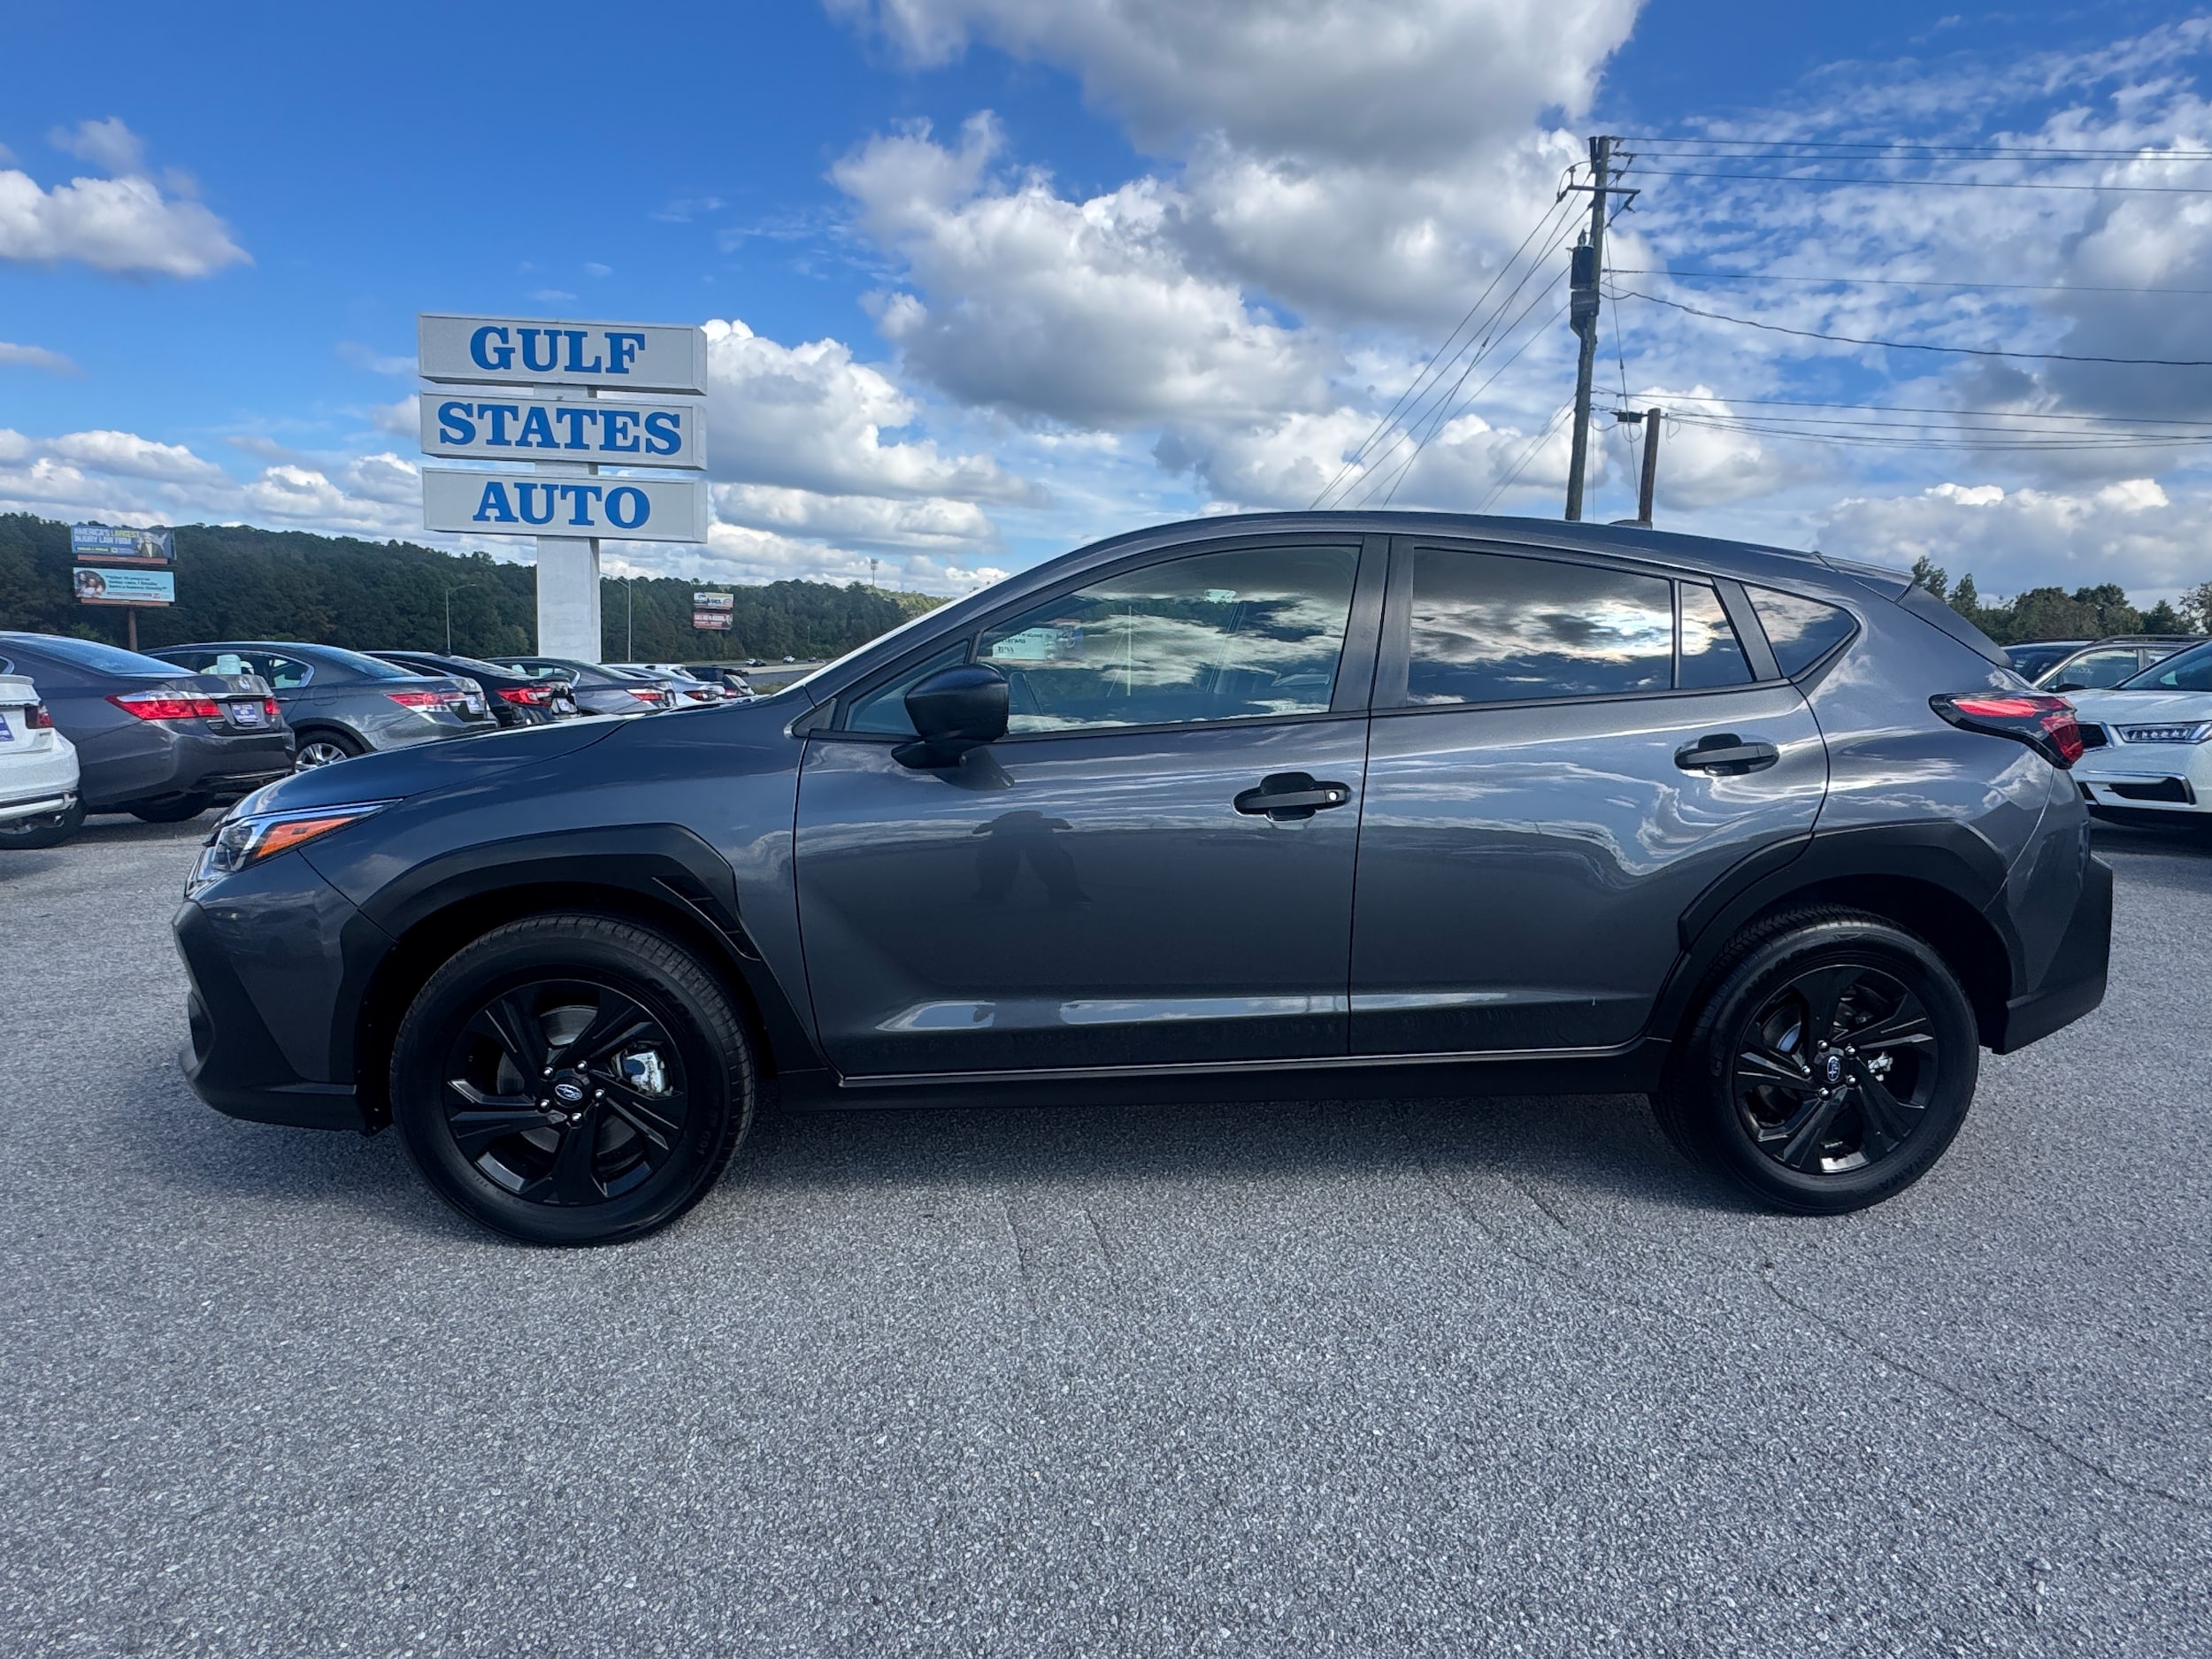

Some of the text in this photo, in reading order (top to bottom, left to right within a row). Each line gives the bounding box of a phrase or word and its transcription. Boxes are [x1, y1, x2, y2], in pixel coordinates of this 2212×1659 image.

[470, 326, 646, 374] GULF
[437, 401, 682, 456] STATES
[472, 481, 651, 529] AUTO
